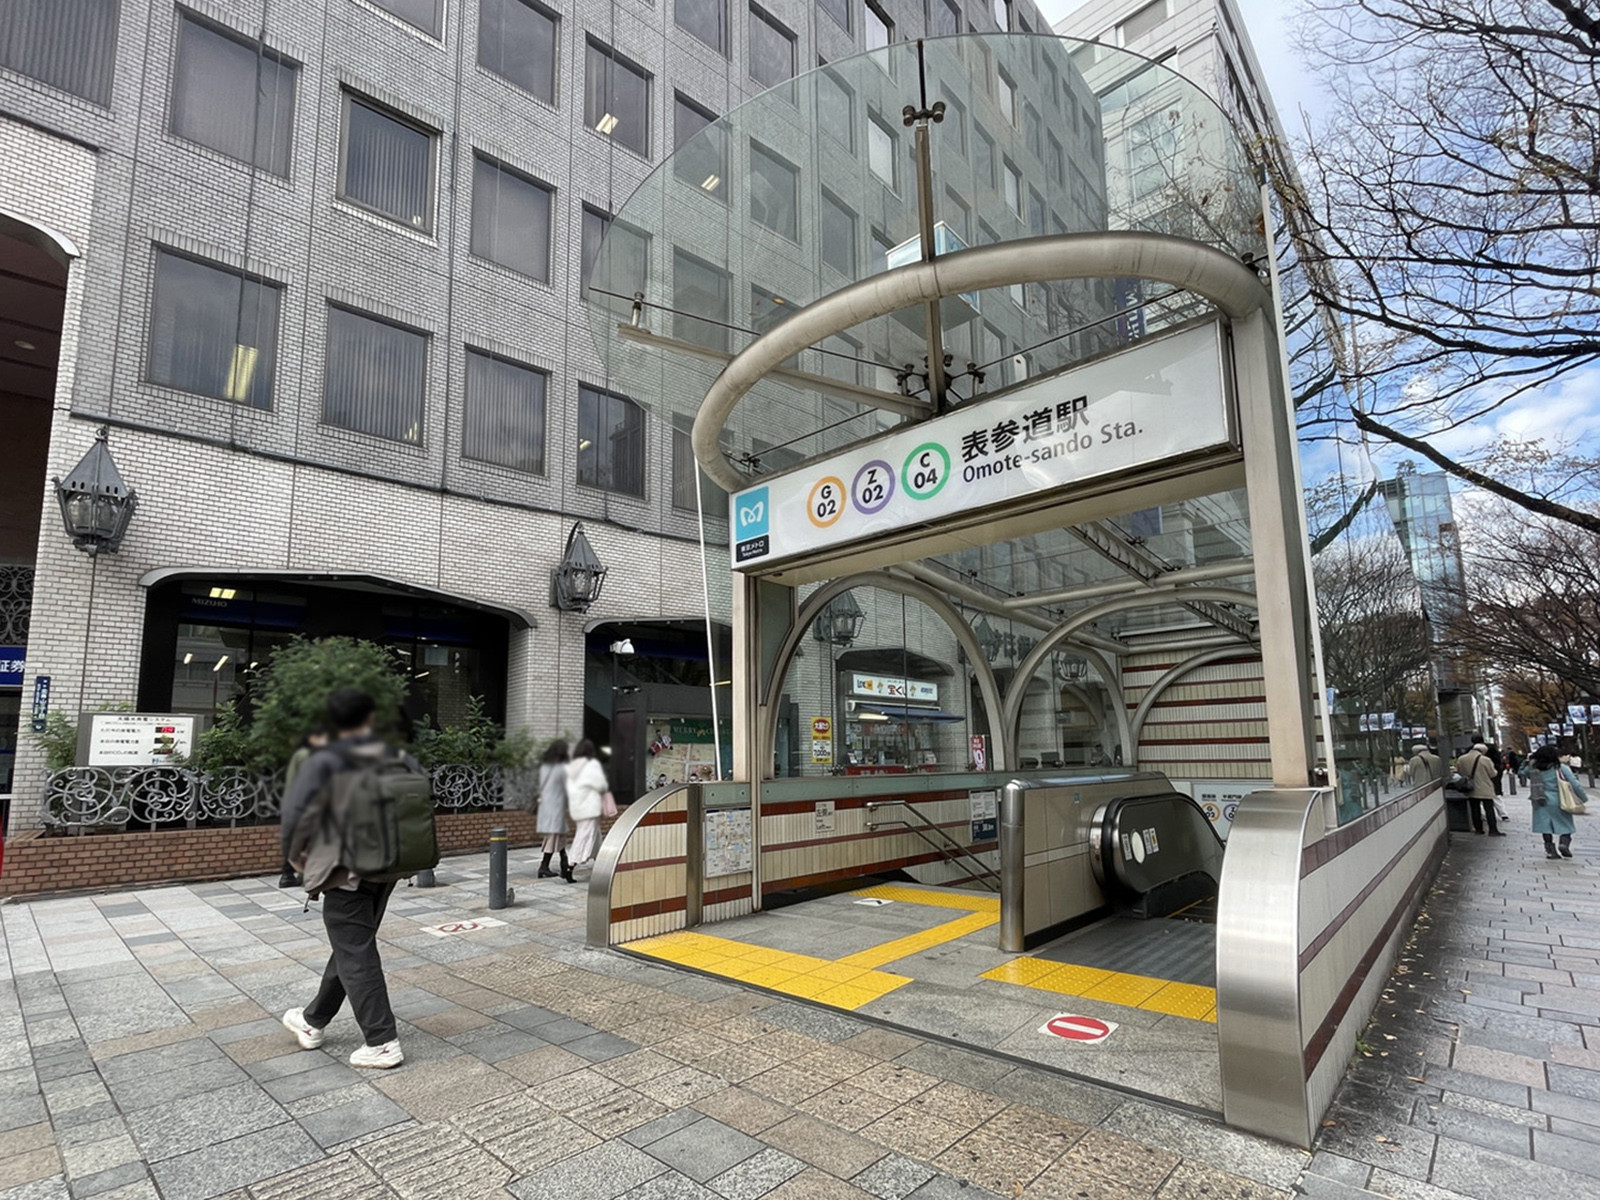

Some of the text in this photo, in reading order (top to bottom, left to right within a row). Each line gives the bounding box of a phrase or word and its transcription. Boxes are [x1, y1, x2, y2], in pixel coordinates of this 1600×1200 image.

[961, 395, 1090, 463] 表参道駅
[919, 452, 931, 468] C
[963, 420, 1143, 483] Omote-sando Sta.
[867, 469, 877, 485] Z
[914, 468, 938, 489] 04
[821, 485, 832, 499] G
[862, 484, 884, 504] 02
[817, 500, 837, 518] 02
